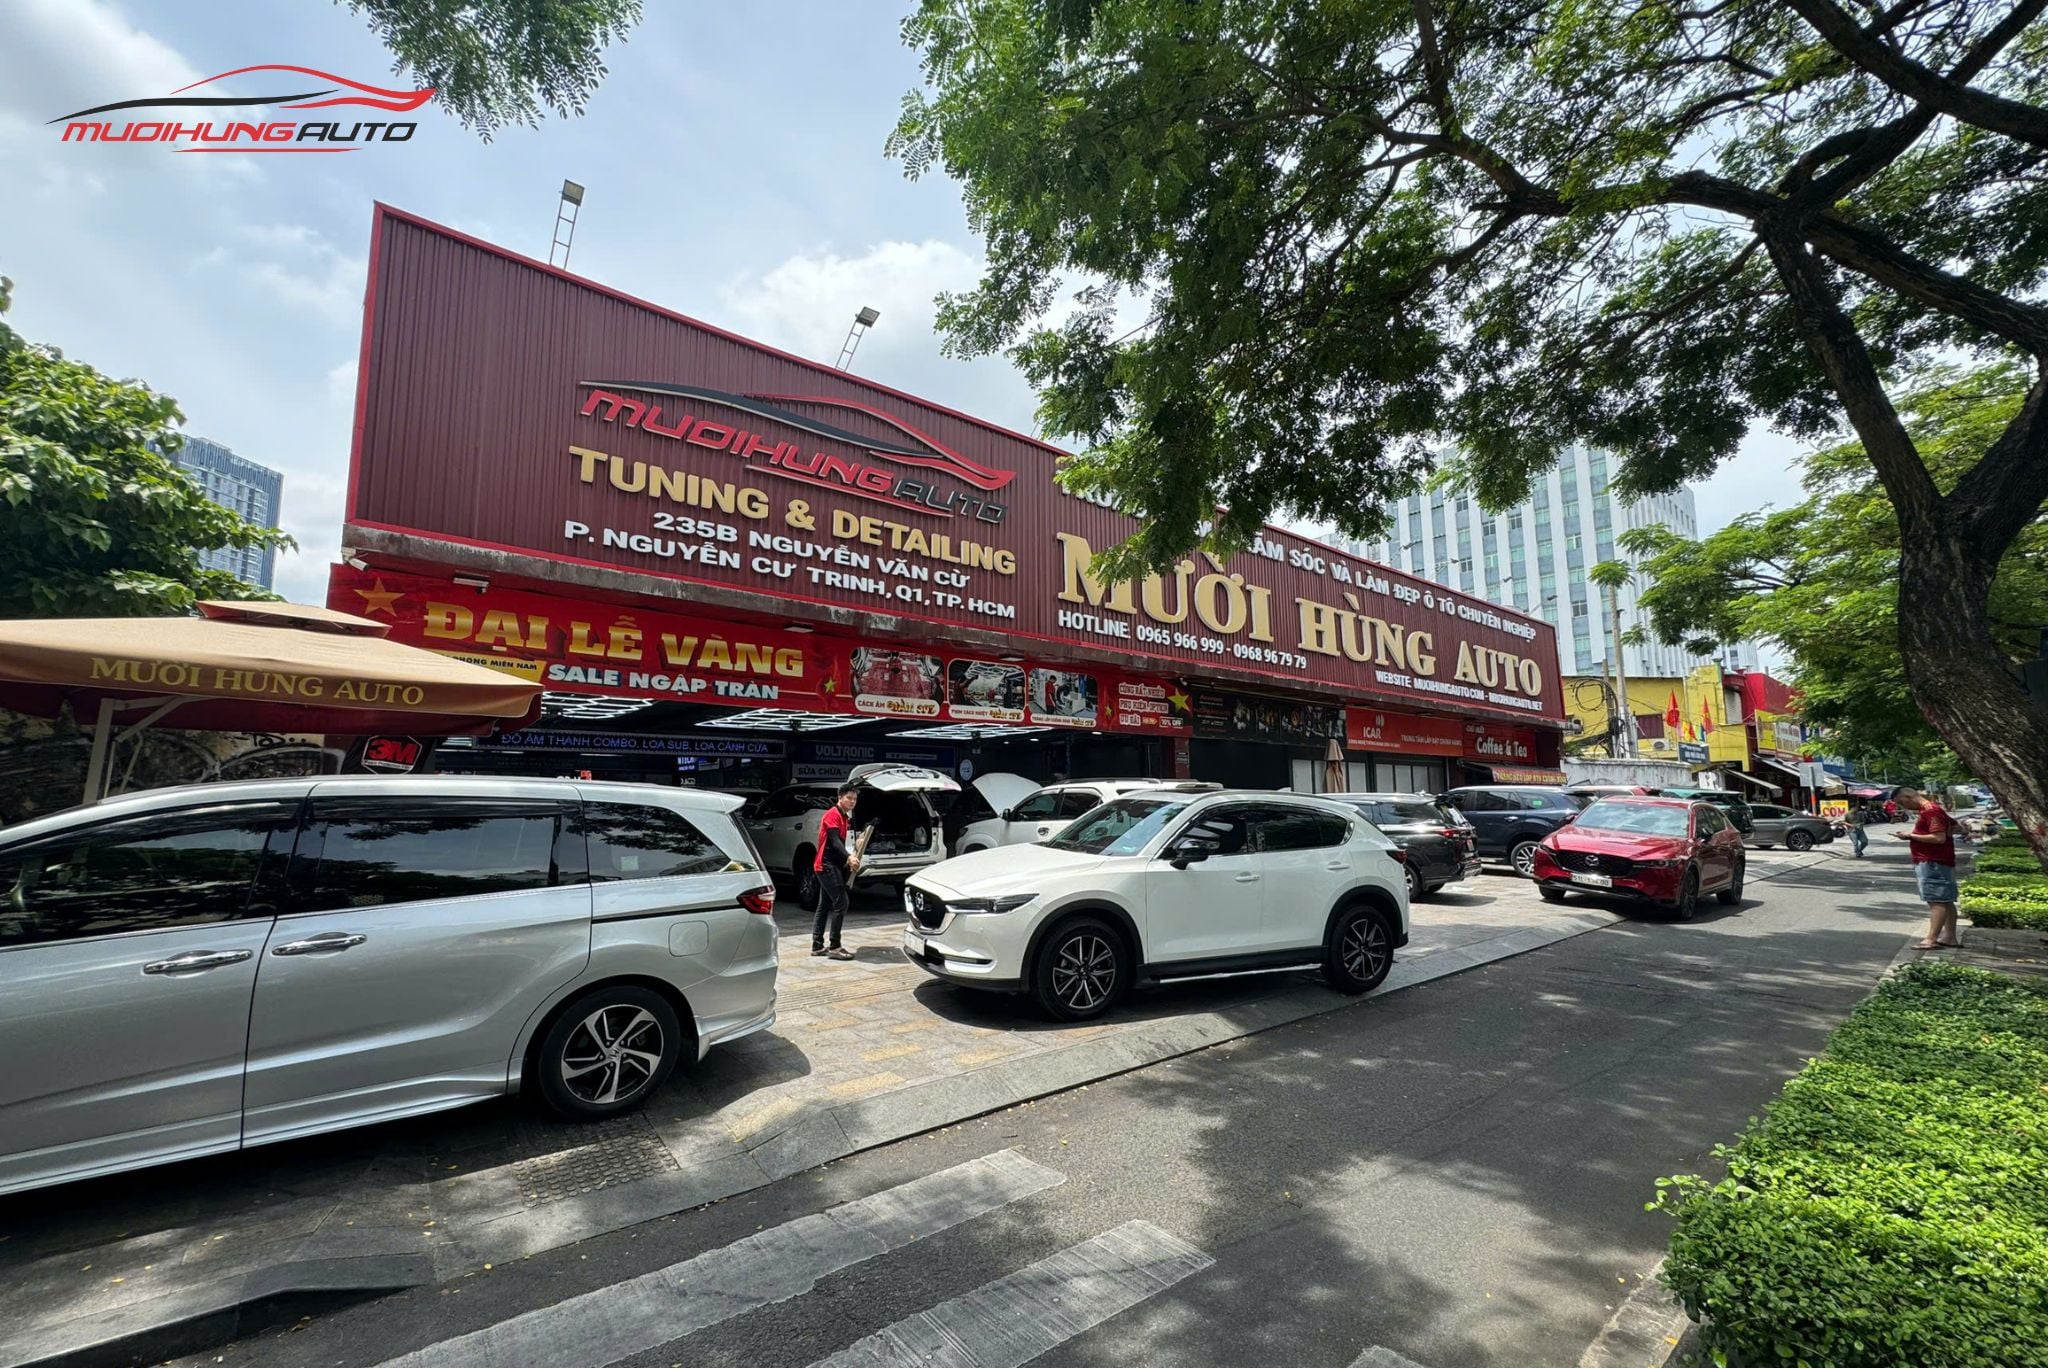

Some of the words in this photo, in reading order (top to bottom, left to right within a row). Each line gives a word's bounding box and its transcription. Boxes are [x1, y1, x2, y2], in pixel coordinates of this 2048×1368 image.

[568, 445, 769, 520] TUNING
[785, 499, 816, 531] &
[833, 509, 1016, 575] DETAILING
[653, 512, 738, 543] 235B
[750, 530, 870, 570] NGUYỄN
[876, 557, 929, 581] VĂN
[934, 569, 971, 588] CỪ
[564, 520, 595, 543] P.
[603, 528, 741, 569] NGUYỄN
[751, 557, 797, 578] CƯ
[968, 598, 1016, 619] HCM
[1289, 547, 1326, 575] SÓC
[1330, 560, 1353, 584] VÀ
[1356, 569, 1390, 596] LÀM
[1393, 583, 1420, 606] ĐẸP
[1423, 590, 1434, 609] Ô
[1437, 597, 1456, 616] TÔ
[1457, 604, 1501, 630] CHUYÊN
[1502, 619, 1537, 643] NGHIỆP
[1056, 531, 1275, 644] MƯỜI
[1295, 592, 1437, 676] HÙNG
[1454, 640, 1542, 697] AUTO
[423, 601, 550, 651] ĐẠI
[569, 614, 643, 661] LỄ
[661, 633, 804, 678] VÀNG
[1136, 625, 1171, 646] 0965
[1173, 632, 1198, 650] 966
[1200, 637, 1224, 655] 999
[1233, 643, 1262, 661] 0968
[333, 677, 425, 705] AUTO
[548, 664, 620, 687] SALE
[629, 672, 707, 696] NGẬP
[714, 679, 779, 700] TRÀN
[548, 735, 590, 746] THANH
[642, 739, 665, 749] LOA
[695, 742, 716, 751] LOA
[816, 744, 875, 758] VOLTRONIC
[1363, 726, 1381, 740] ICAR
[1476, 736, 1503, 755] Coffee
[1513, 740, 1527, 758] Tea
[368, 739, 418, 765] 3M
[798, 767, 817, 776] SỬA
[818, 767, 842, 776] CHỮA
